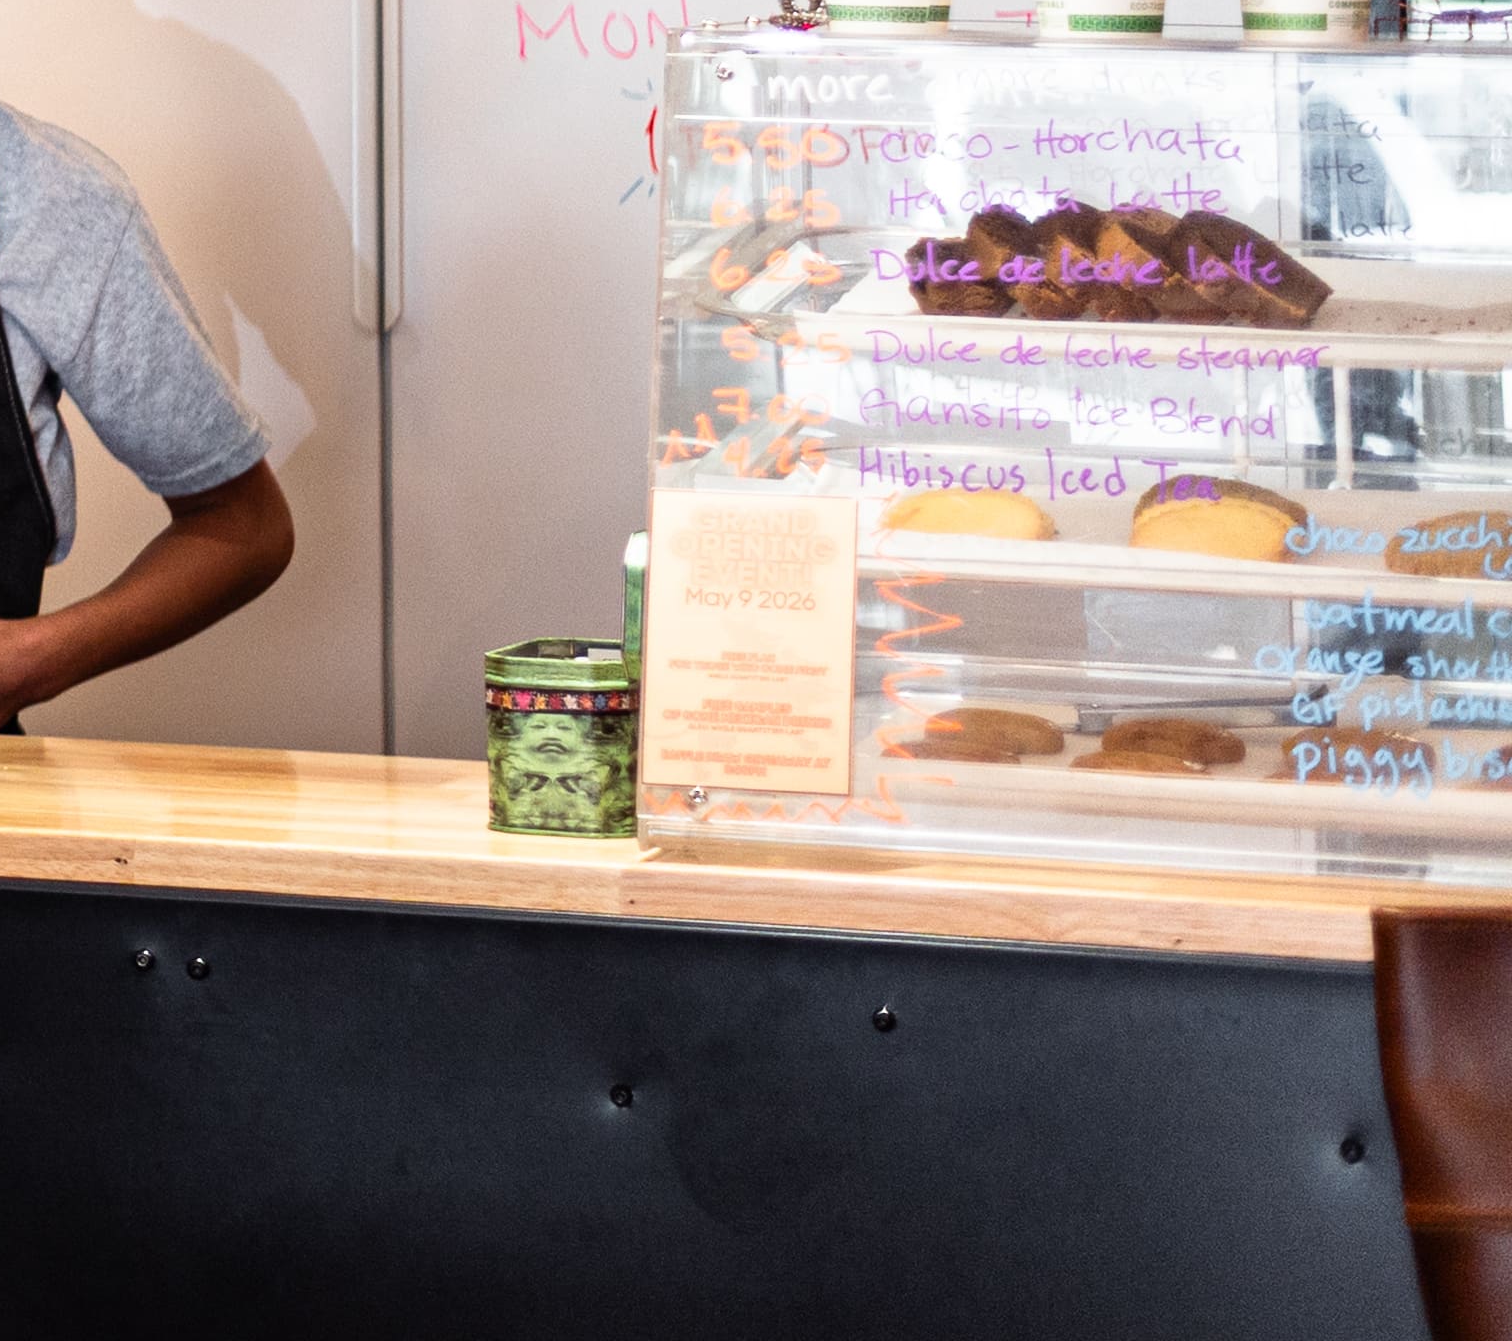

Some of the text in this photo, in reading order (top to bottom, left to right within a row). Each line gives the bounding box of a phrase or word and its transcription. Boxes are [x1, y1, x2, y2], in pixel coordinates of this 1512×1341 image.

[870, 241, 981, 283] Dulce
[998, 251, 1046, 284] de
[865, 326, 981, 364] Dulce
[999, 334, 1047, 366] de
[1065, 333, 1156, 368] leche
[1150, 397, 1276, 438] Blend
[859, 445, 1025, 493] Hibiscus
[1142, 459, 1222, 503] Tea
[685, 587, 817, 611] May 9 2026
[1304, 588, 1475, 639] oatmeal
[1291, 737, 1435, 800] piggy
